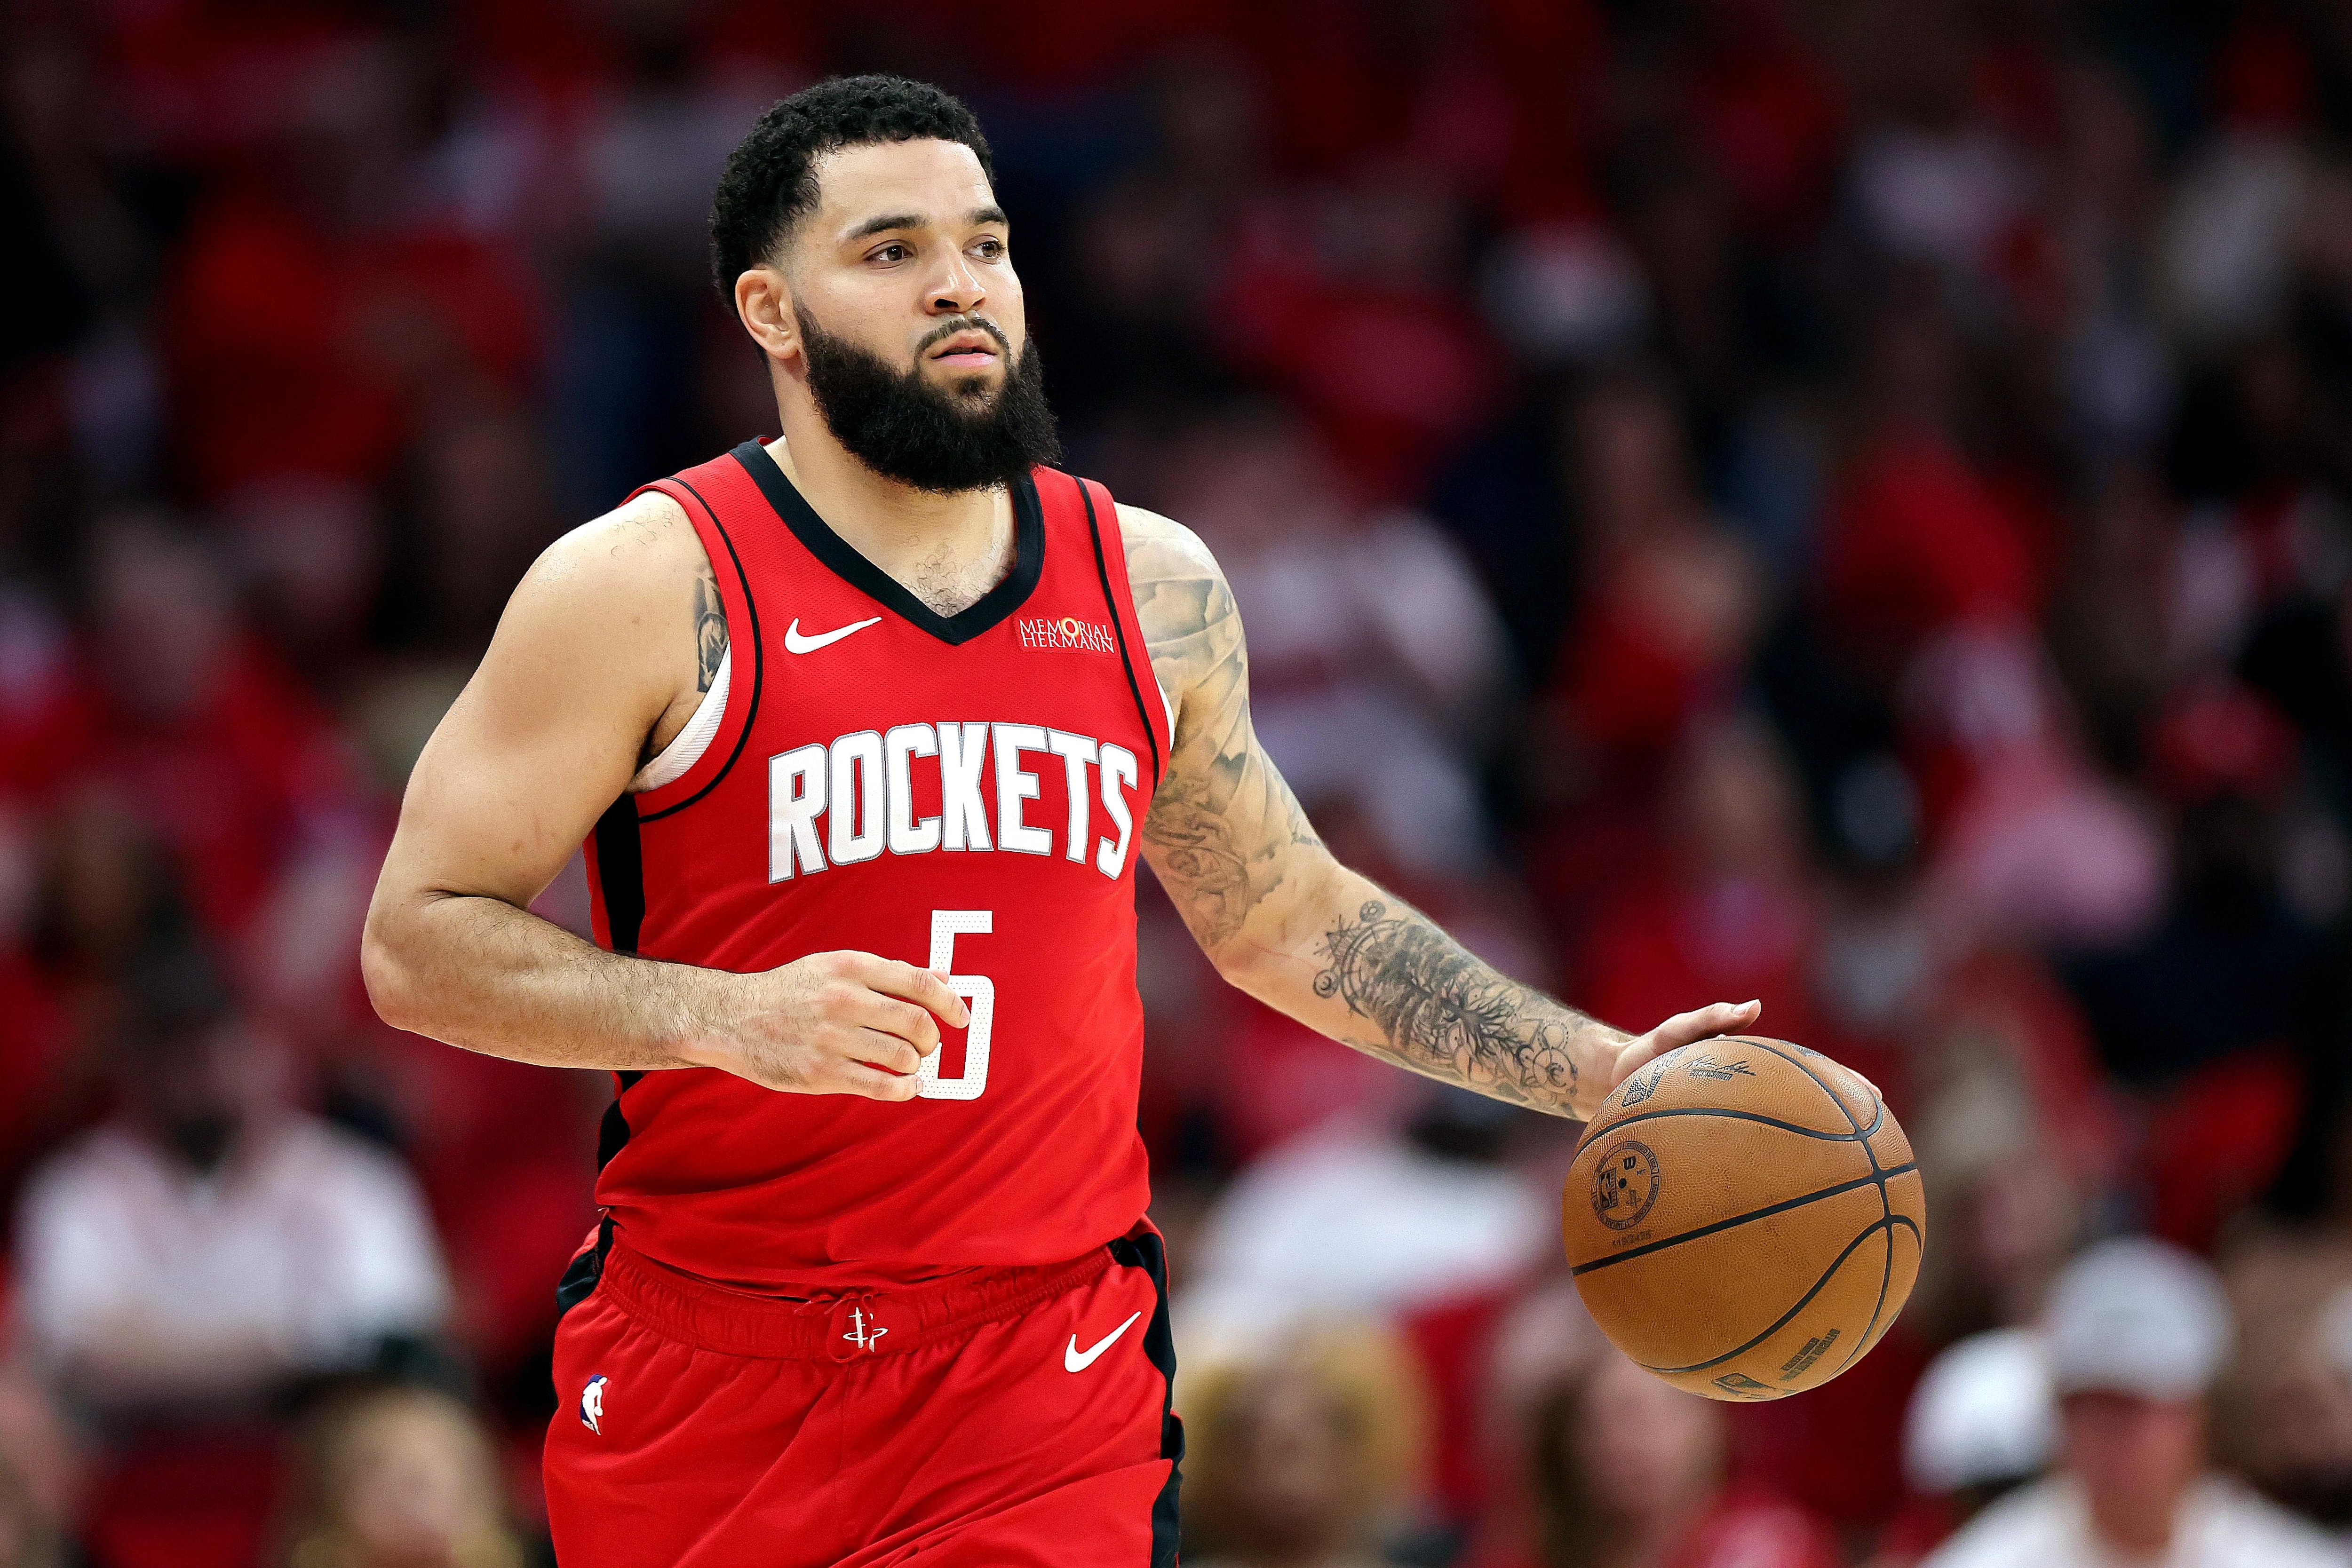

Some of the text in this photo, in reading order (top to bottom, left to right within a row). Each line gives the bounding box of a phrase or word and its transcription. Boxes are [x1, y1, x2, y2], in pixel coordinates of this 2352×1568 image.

[1019, 617, 1113, 640] MEMORIAL
[1020, 632, 1114, 653] HERMANN
[769, 721, 1138, 884] ROCKETS
[917, 910, 995, 1100] 5
